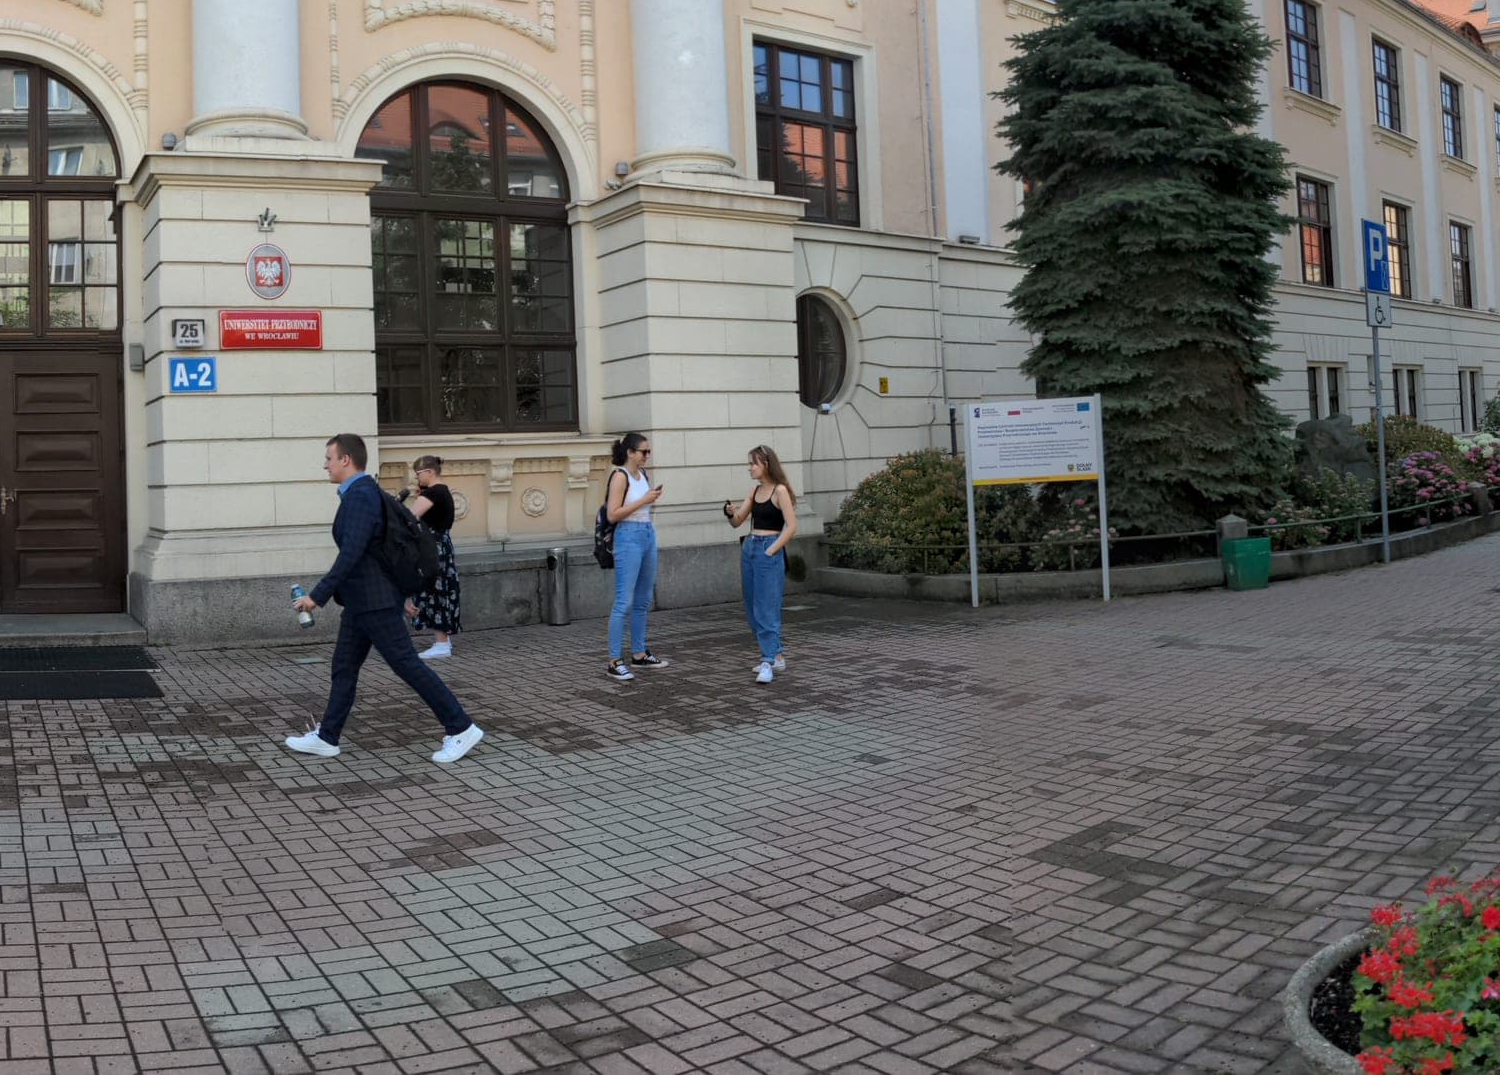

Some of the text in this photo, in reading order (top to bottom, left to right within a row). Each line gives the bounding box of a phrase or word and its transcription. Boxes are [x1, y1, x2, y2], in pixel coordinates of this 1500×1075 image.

[1369, 228, 1383, 271] P
[180, 323, 198, 338] 25
[224, 319, 317, 330] UNIWERSYTET PRZYRODNICZY
[244, 332, 256, 340] WE
[173, 362, 212, 387] A-2
